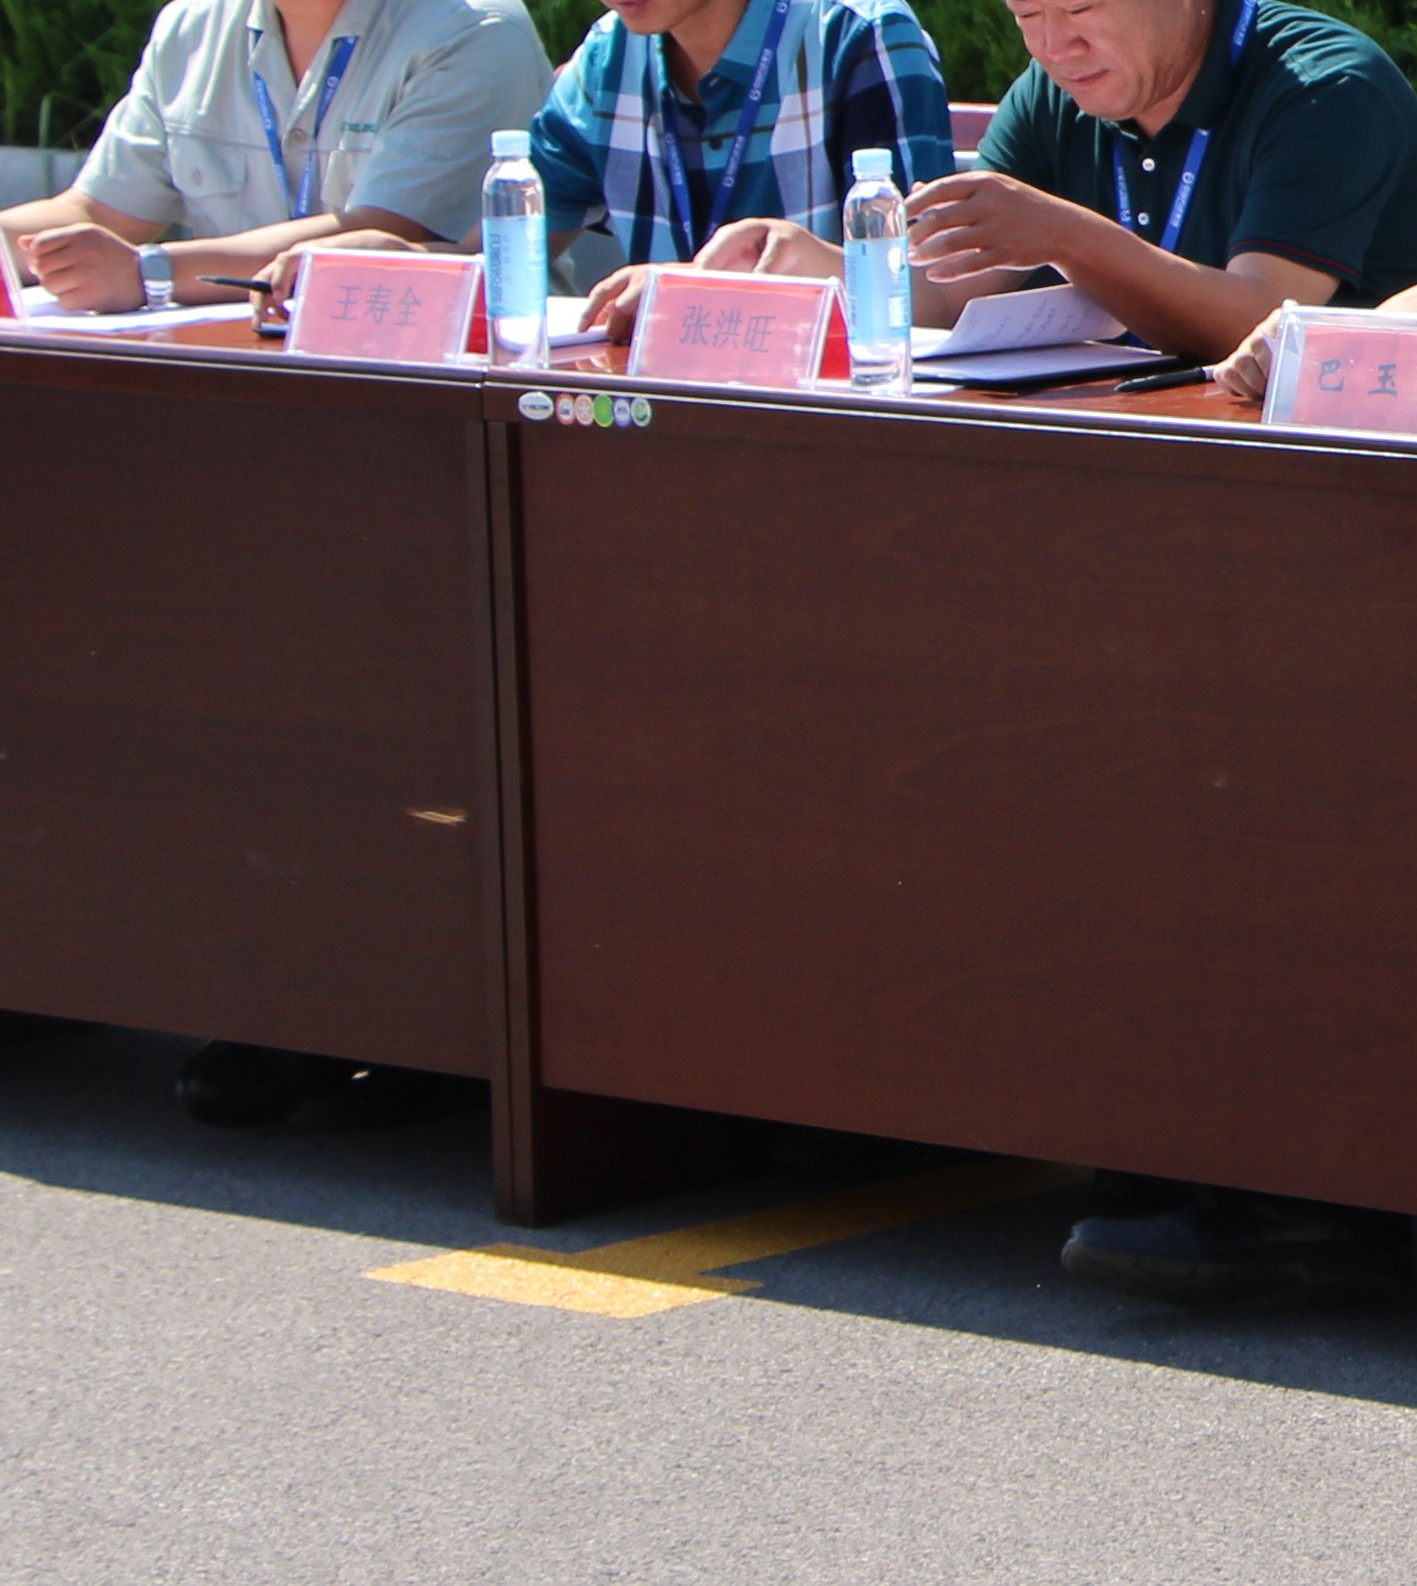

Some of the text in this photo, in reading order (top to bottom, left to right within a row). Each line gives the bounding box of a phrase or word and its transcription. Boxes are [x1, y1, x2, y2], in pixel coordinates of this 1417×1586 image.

[329, 283, 423, 327] 王寿全
[678, 304, 777, 354] 张洪旺
